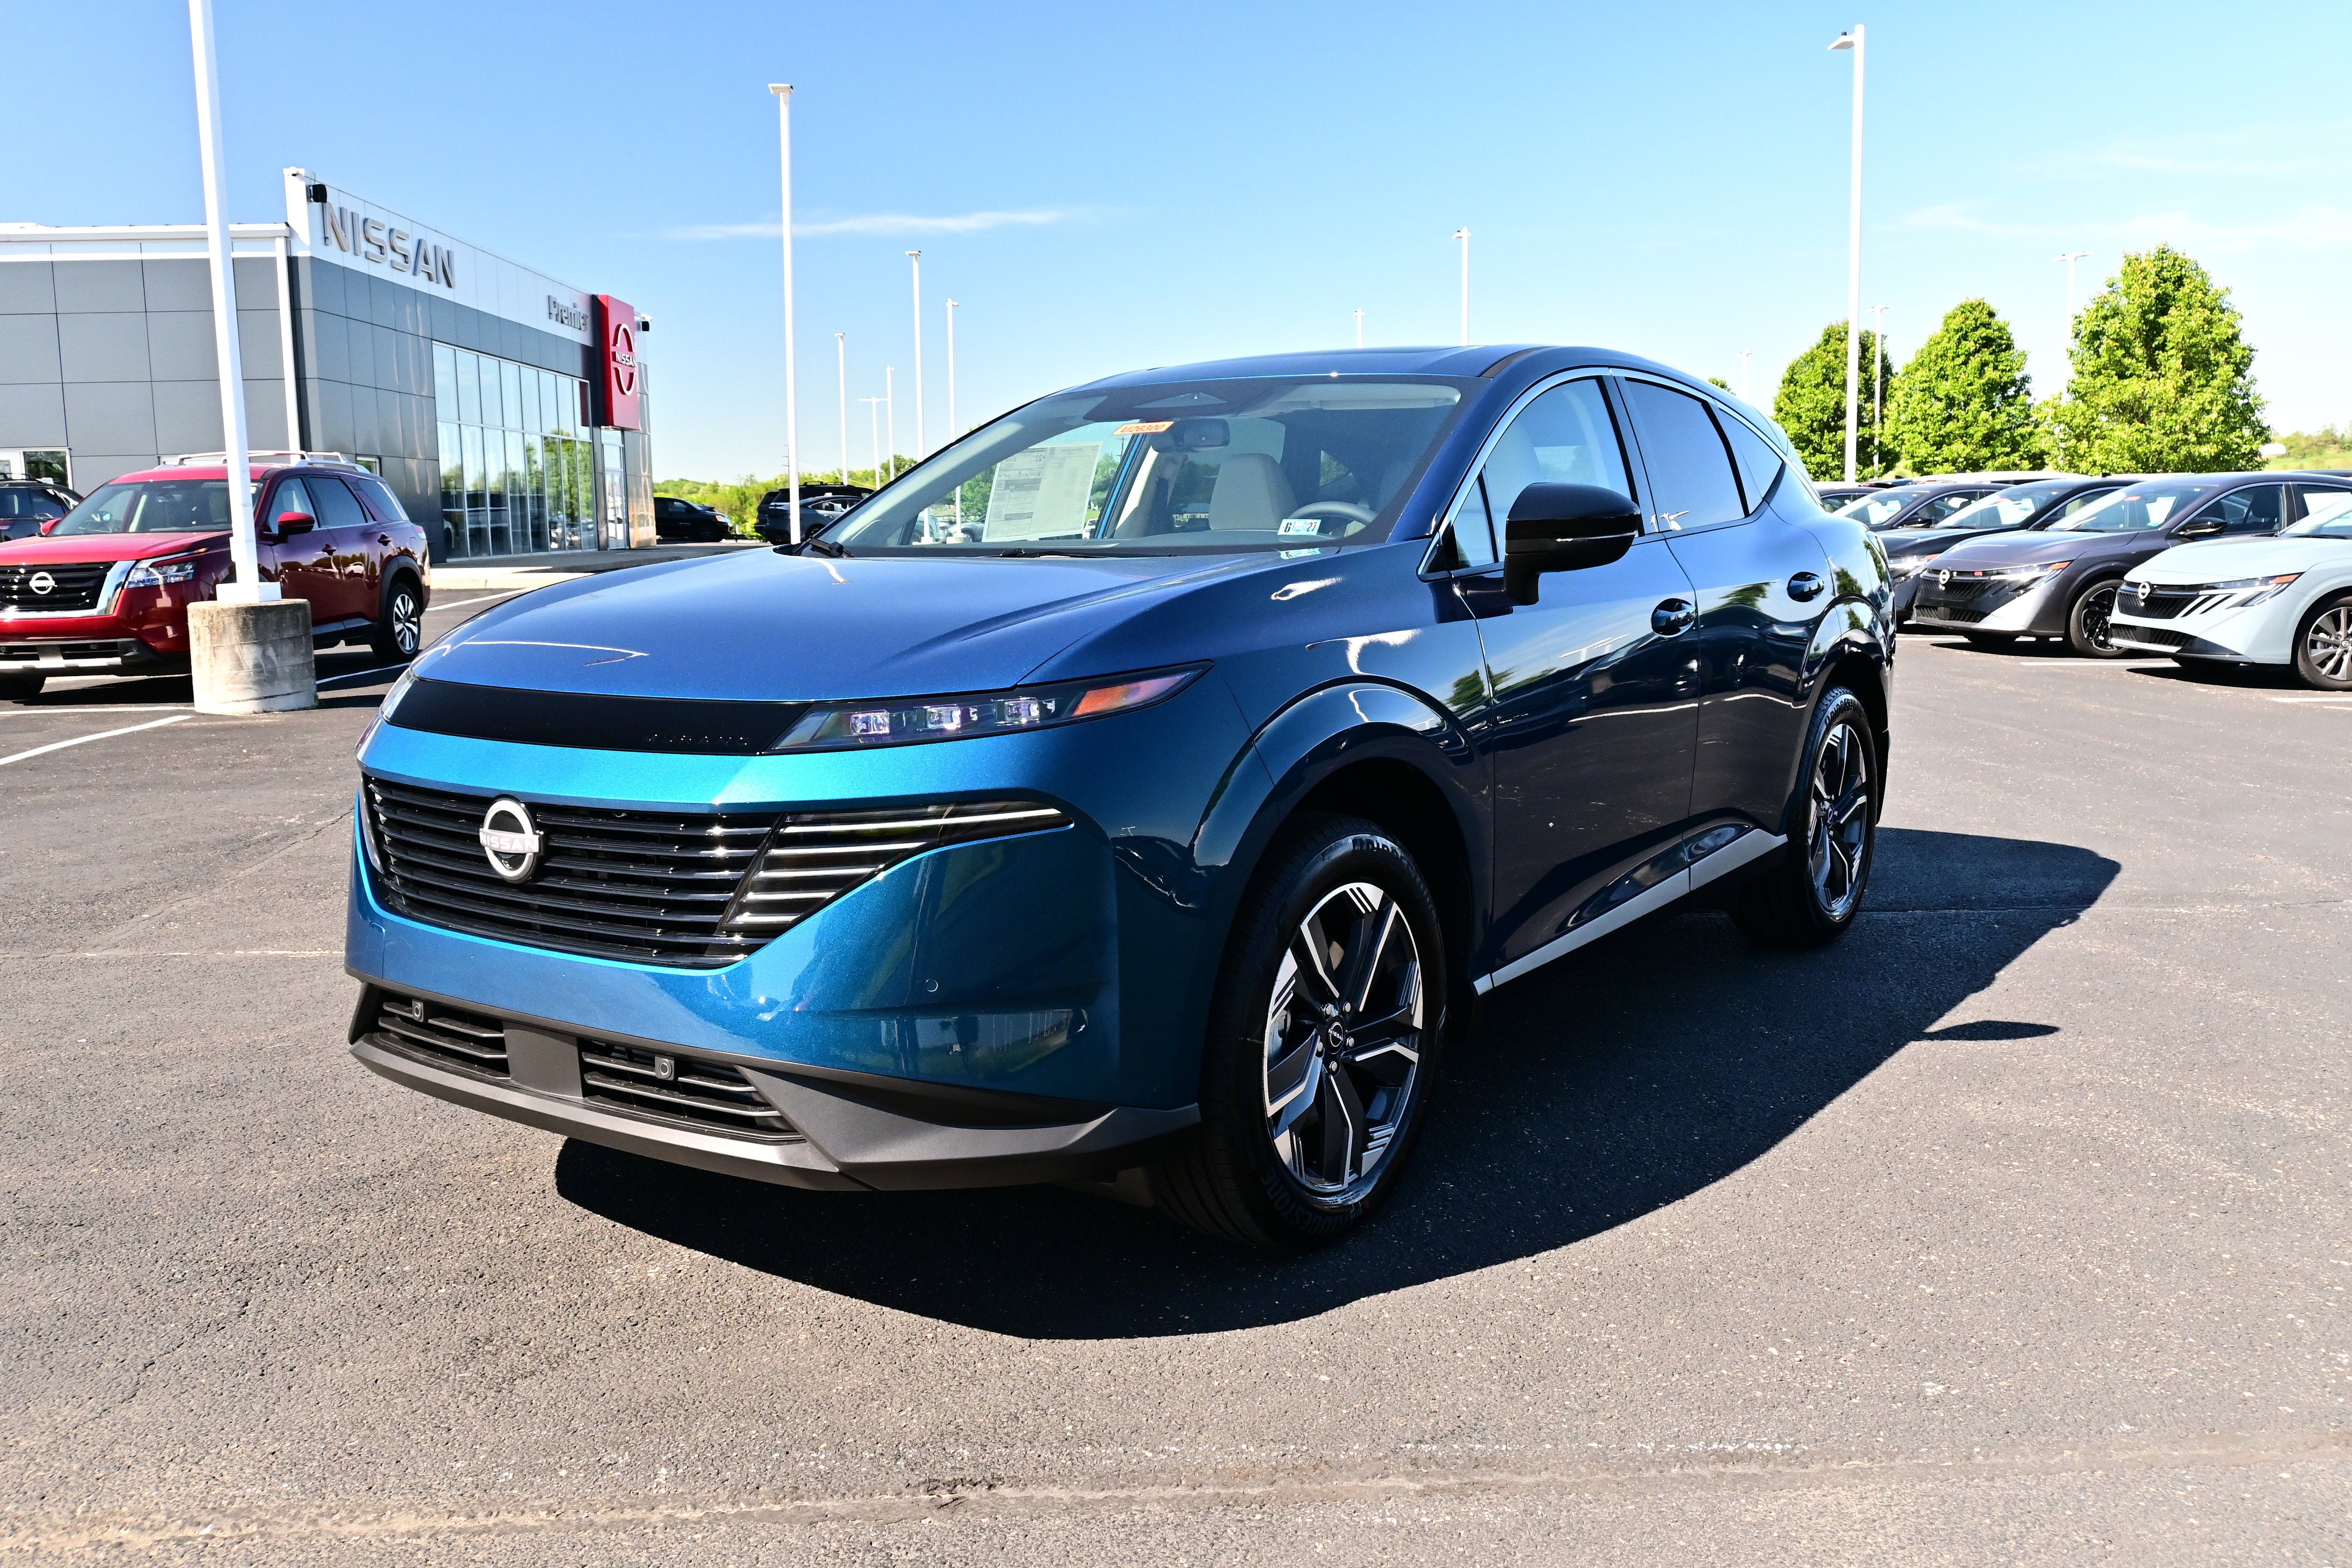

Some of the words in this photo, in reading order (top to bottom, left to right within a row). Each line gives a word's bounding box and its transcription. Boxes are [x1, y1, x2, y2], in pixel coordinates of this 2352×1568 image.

[322, 201, 455, 289] NISSAN
[615, 351, 637, 367] NISSAN
[1307, 522, 1317, 532] 27
[479, 832, 538, 851] NISSAN
[1328, 1028, 1344, 1042] NISSAN
